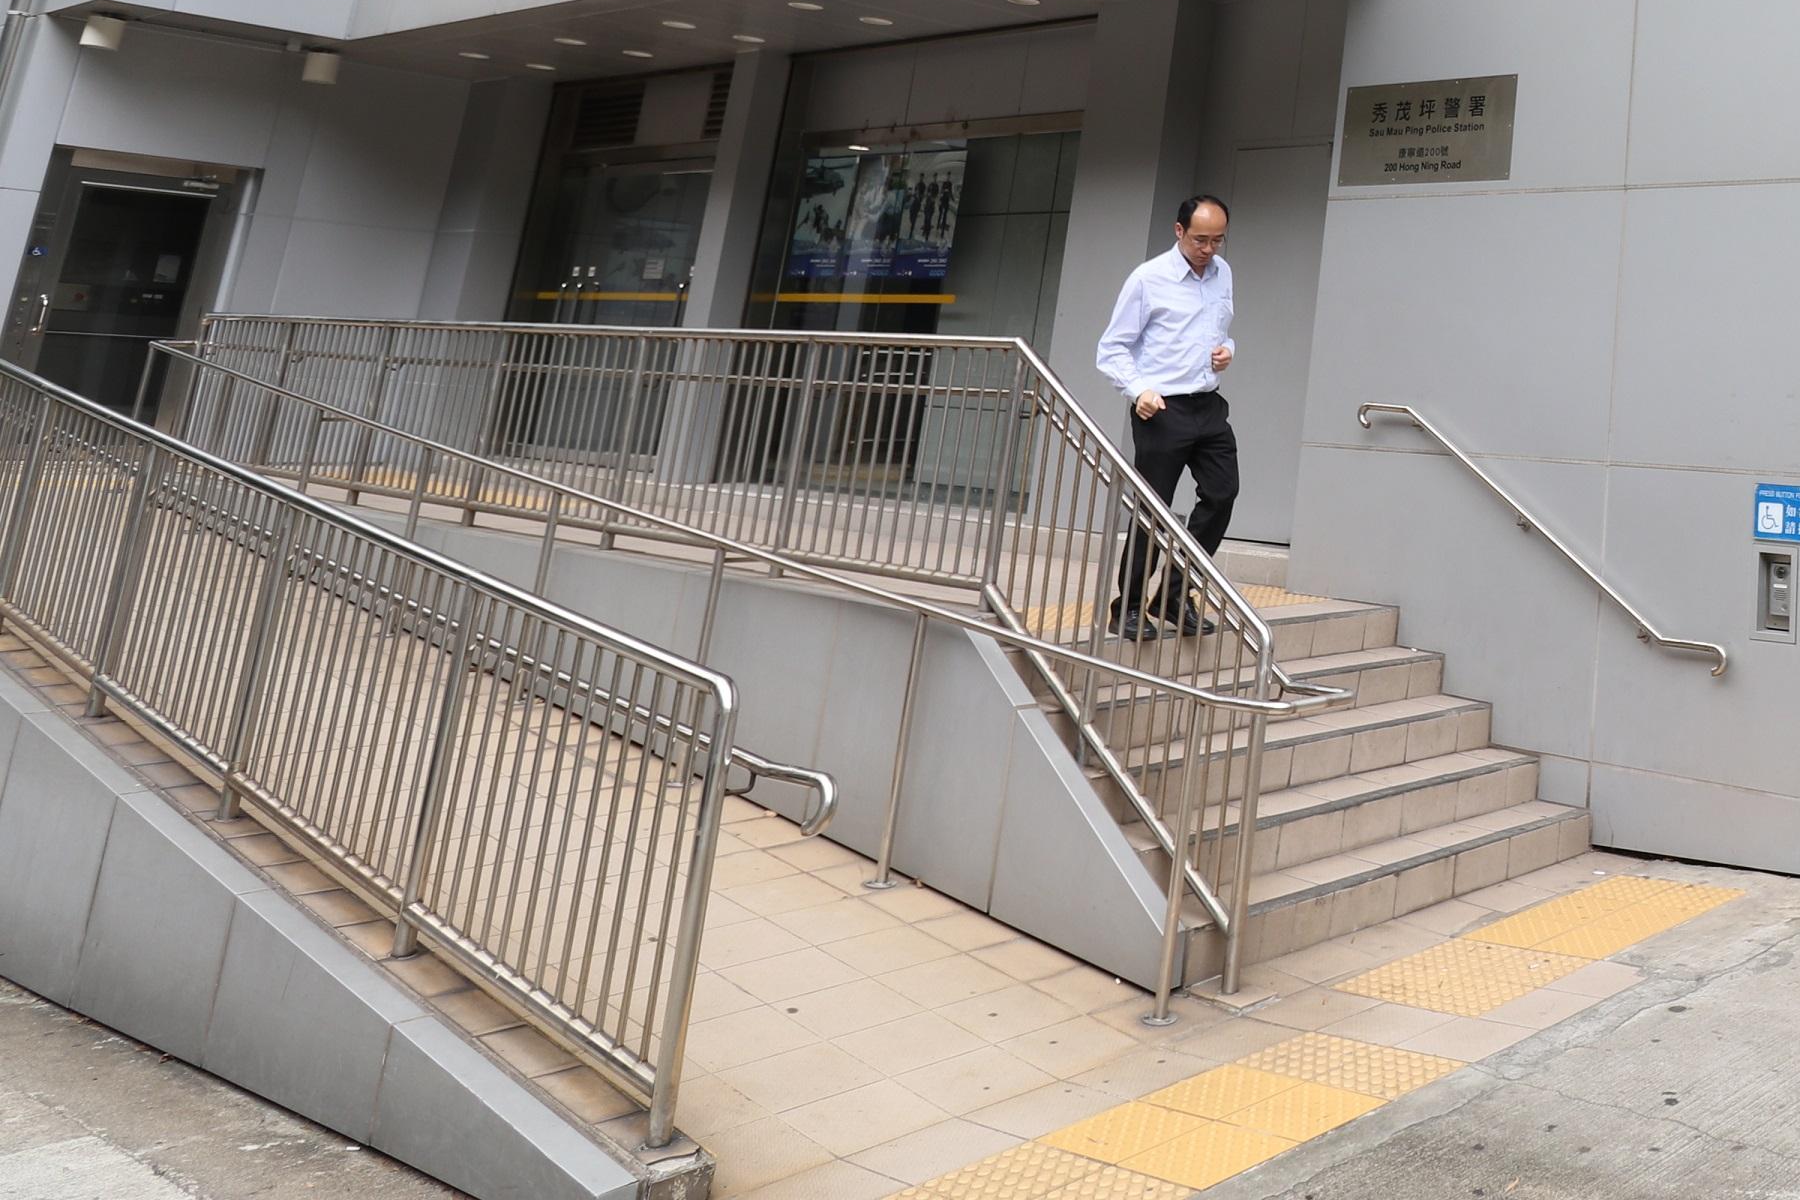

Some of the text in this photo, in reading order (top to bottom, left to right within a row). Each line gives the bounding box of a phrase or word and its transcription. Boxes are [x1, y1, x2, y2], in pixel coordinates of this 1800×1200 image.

[1371, 95, 1486, 123] 秀茂坪警署
[1369, 122, 1485, 137] Sau Mau Ping Police Station
[1399, 163, 1420, 173] Hong
[1421, 161, 1439, 172] Ning
[1441, 160, 1462, 170] Road
